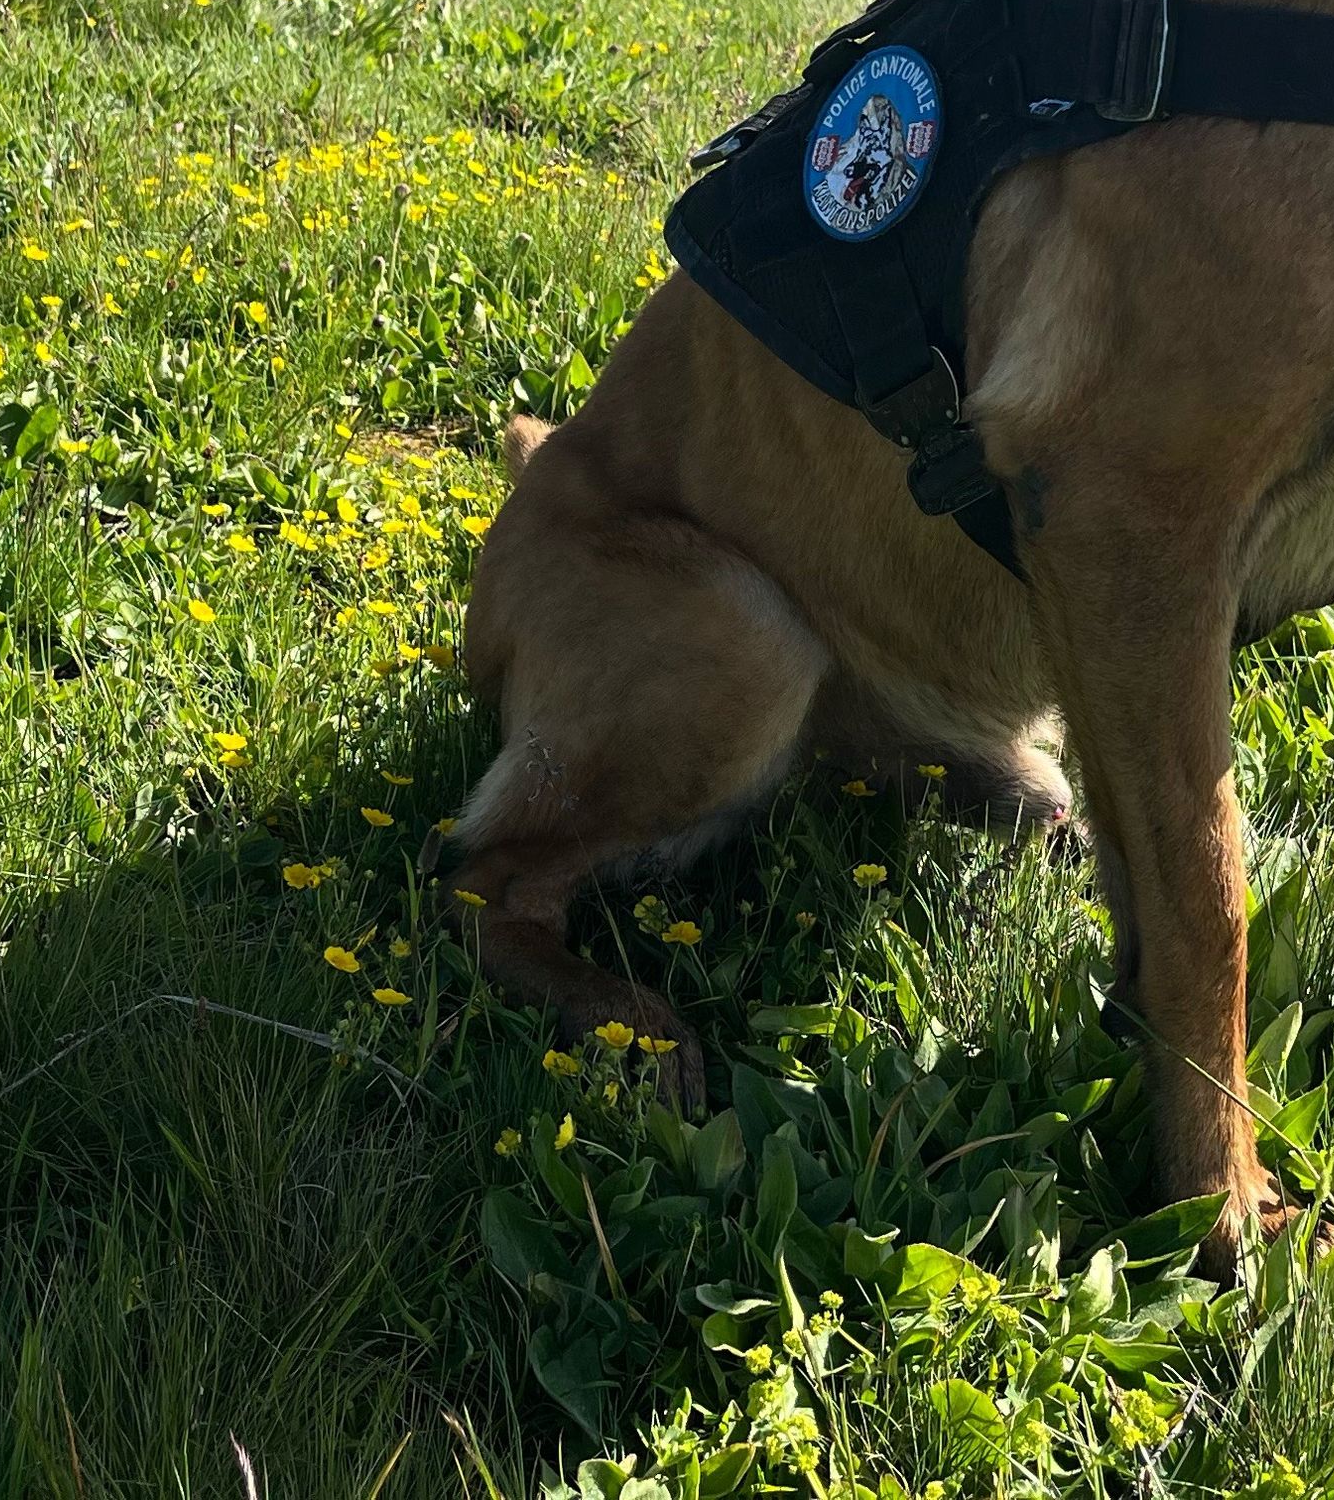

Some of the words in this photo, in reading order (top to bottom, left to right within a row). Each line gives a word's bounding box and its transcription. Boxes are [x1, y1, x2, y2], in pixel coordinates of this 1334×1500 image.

[823, 70, 867, 128] POLICE
[871, 55, 935, 114] CANTONALE
[813, 169, 918, 229] KANTONSPOLIZEI
